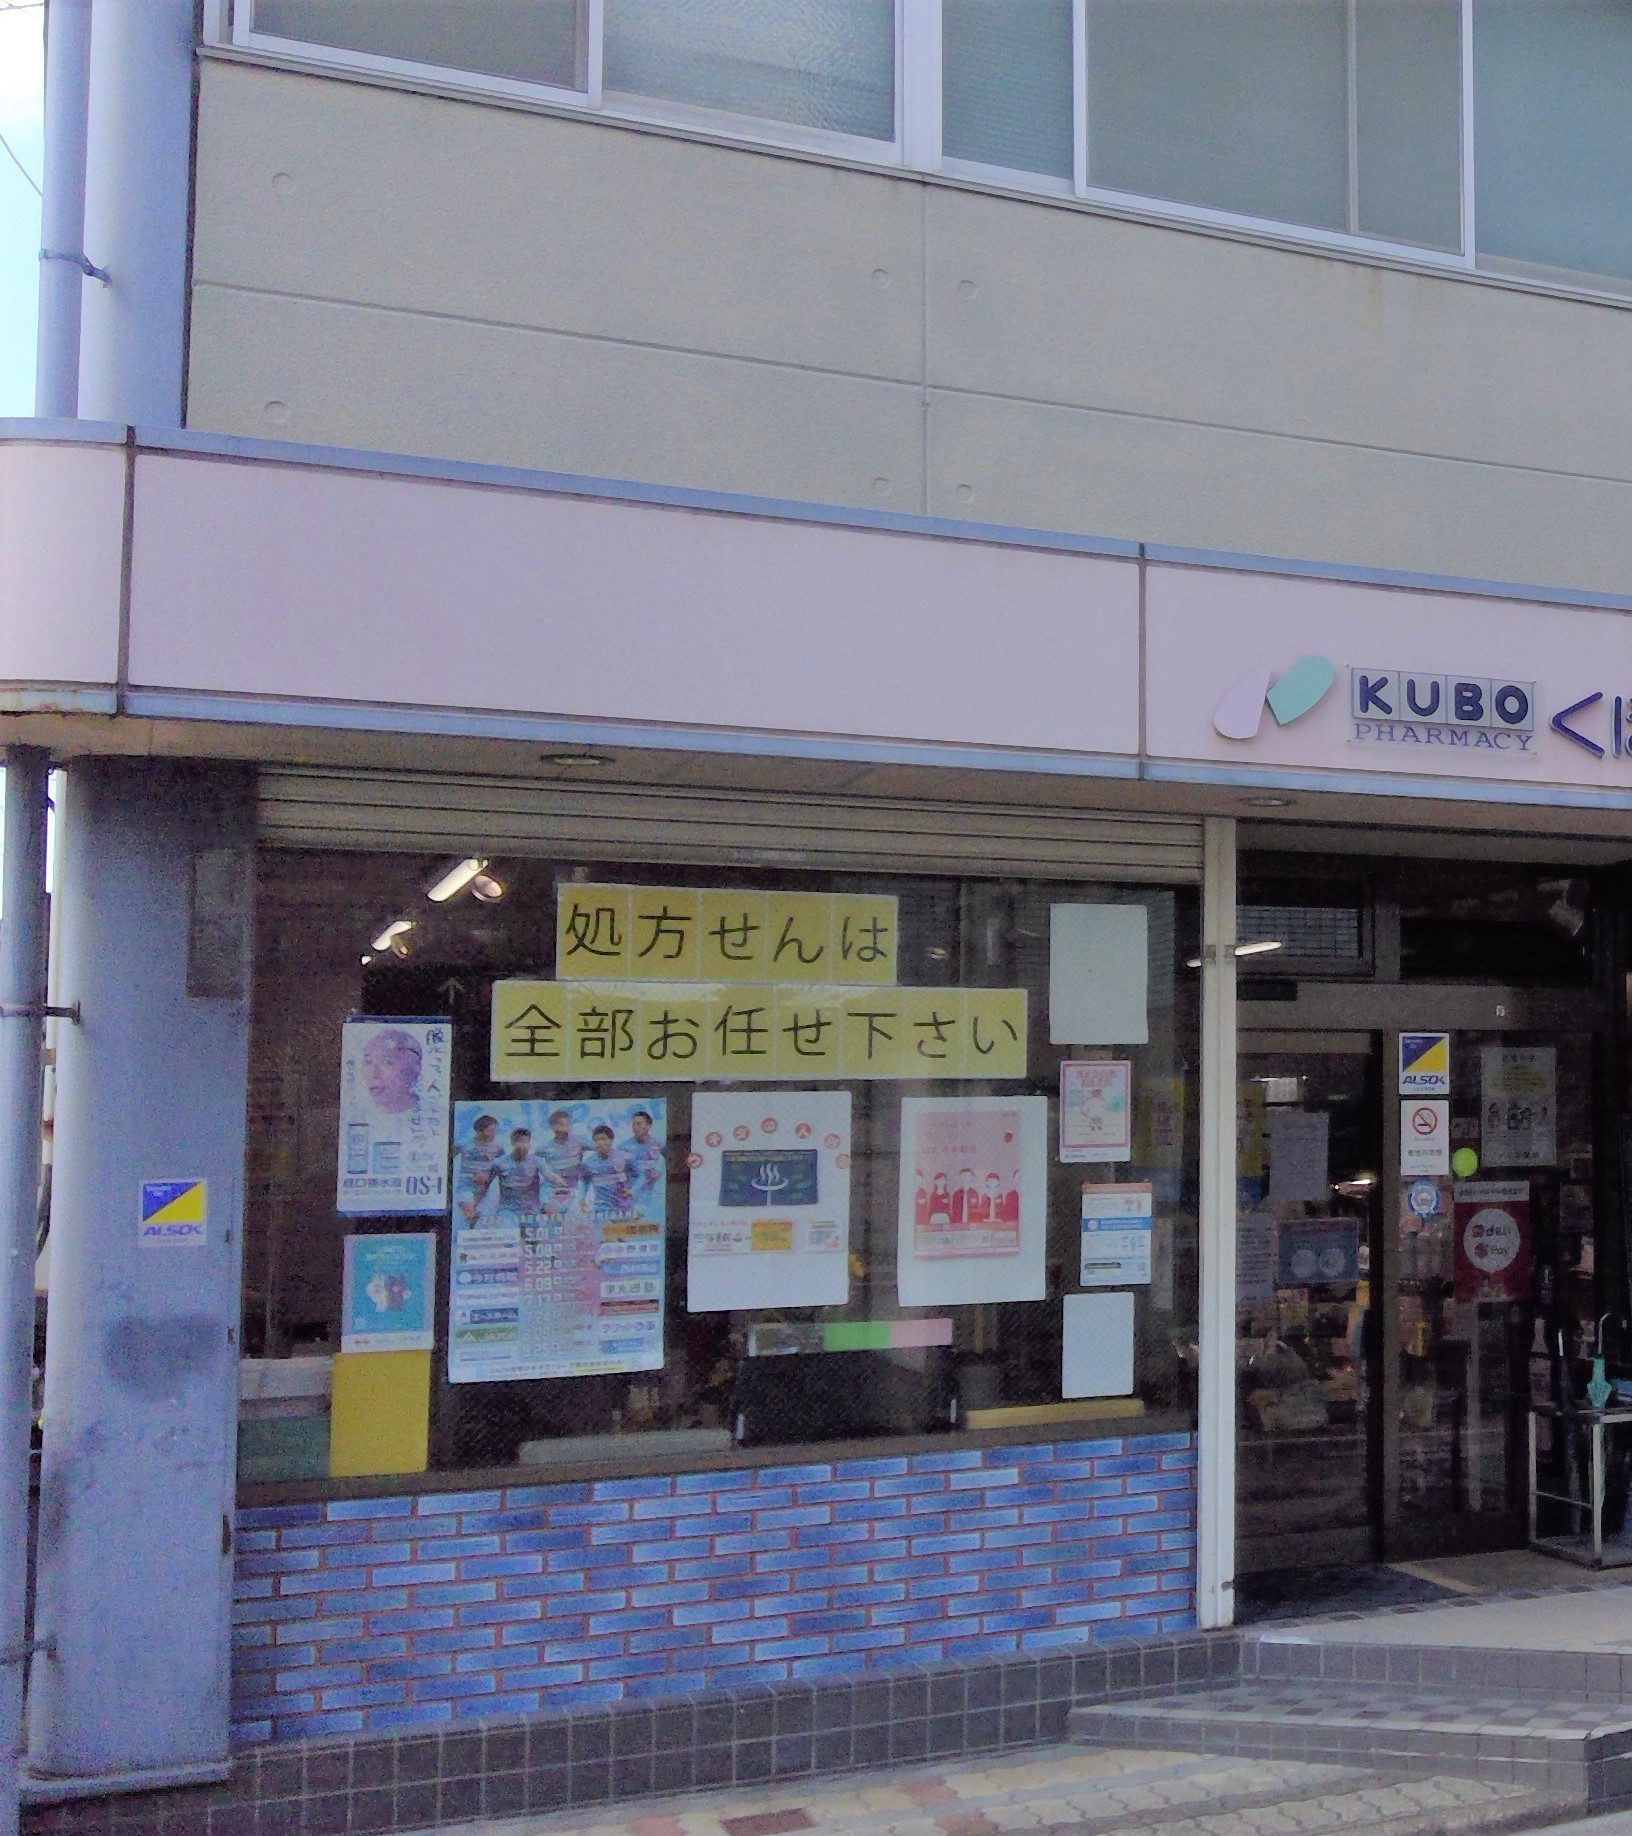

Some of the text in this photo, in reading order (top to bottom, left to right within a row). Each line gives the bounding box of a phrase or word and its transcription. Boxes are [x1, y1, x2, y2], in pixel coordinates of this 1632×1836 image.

[1357, 674, 1529, 726] KUBO
[1354, 722, 1533, 753] PHARMACY
[564, 902, 890, 964] 処方せんは
[503, 1002, 1019, 1061] 全部お任せ下さい
[1402, 1075, 1446, 1086] ALSOK
[405, 1175, 443, 1196] OS-1
